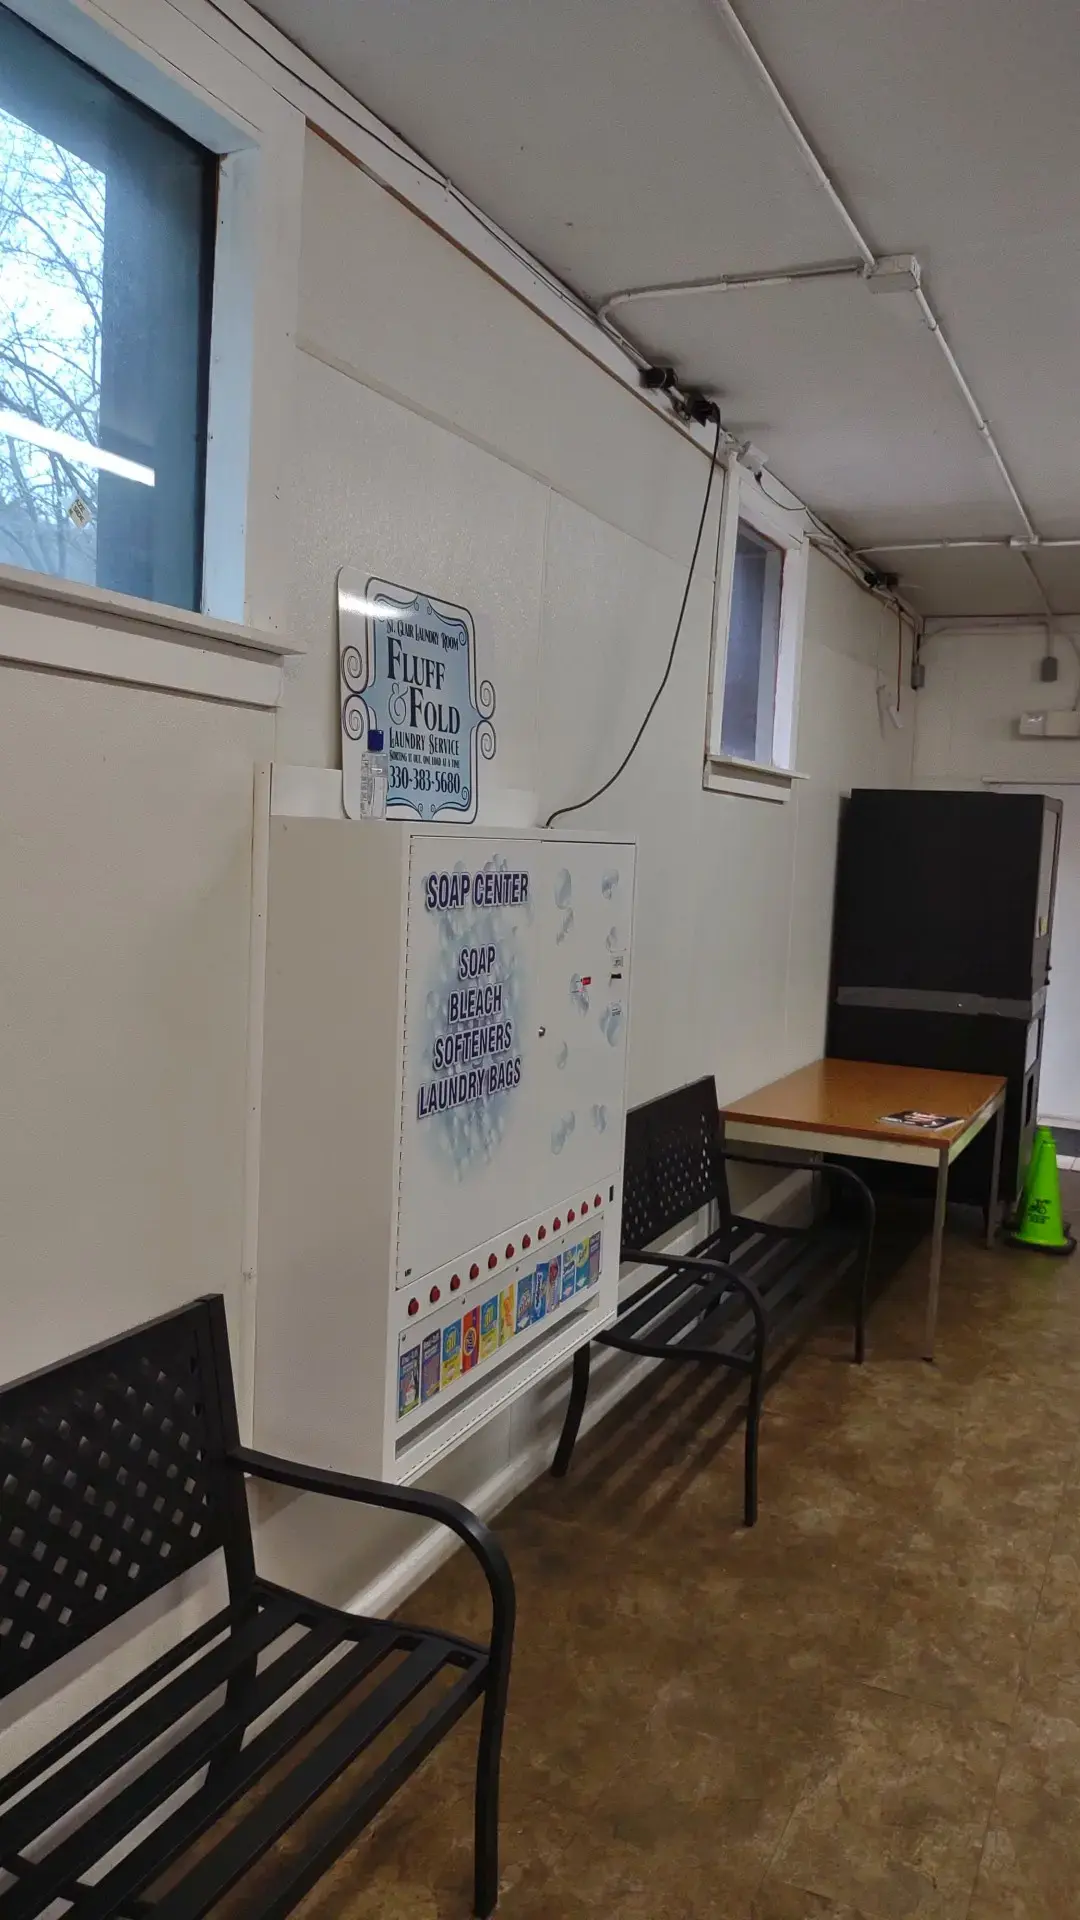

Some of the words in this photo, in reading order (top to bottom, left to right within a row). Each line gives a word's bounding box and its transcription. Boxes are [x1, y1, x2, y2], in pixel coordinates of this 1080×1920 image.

[397, 619, 414, 638] CLAIR
[415, 623, 439, 646] LAUNDRY
[440, 632, 459, 652] ROOM
[386, 635, 446, 690] FLUFF
[387, 682, 407, 725] &
[409, 685, 461, 735] FOLD
[389, 726, 426, 751] LAUNDRY
[428, 733, 460, 756] SERVICE
[389, 765, 461, 795] 330-383-5680
[426, 873, 471, 910] SOAP
[474, 871, 529, 907] CENTER
[458, 945, 496, 979] SOAP
[448, 985, 503, 1023] BLEACH
[432, 1020, 513, 1071] SOFTENERS
[418, 1068, 485, 1118] LAUNDRY
[487, 1058, 521, 1094] BAGS
